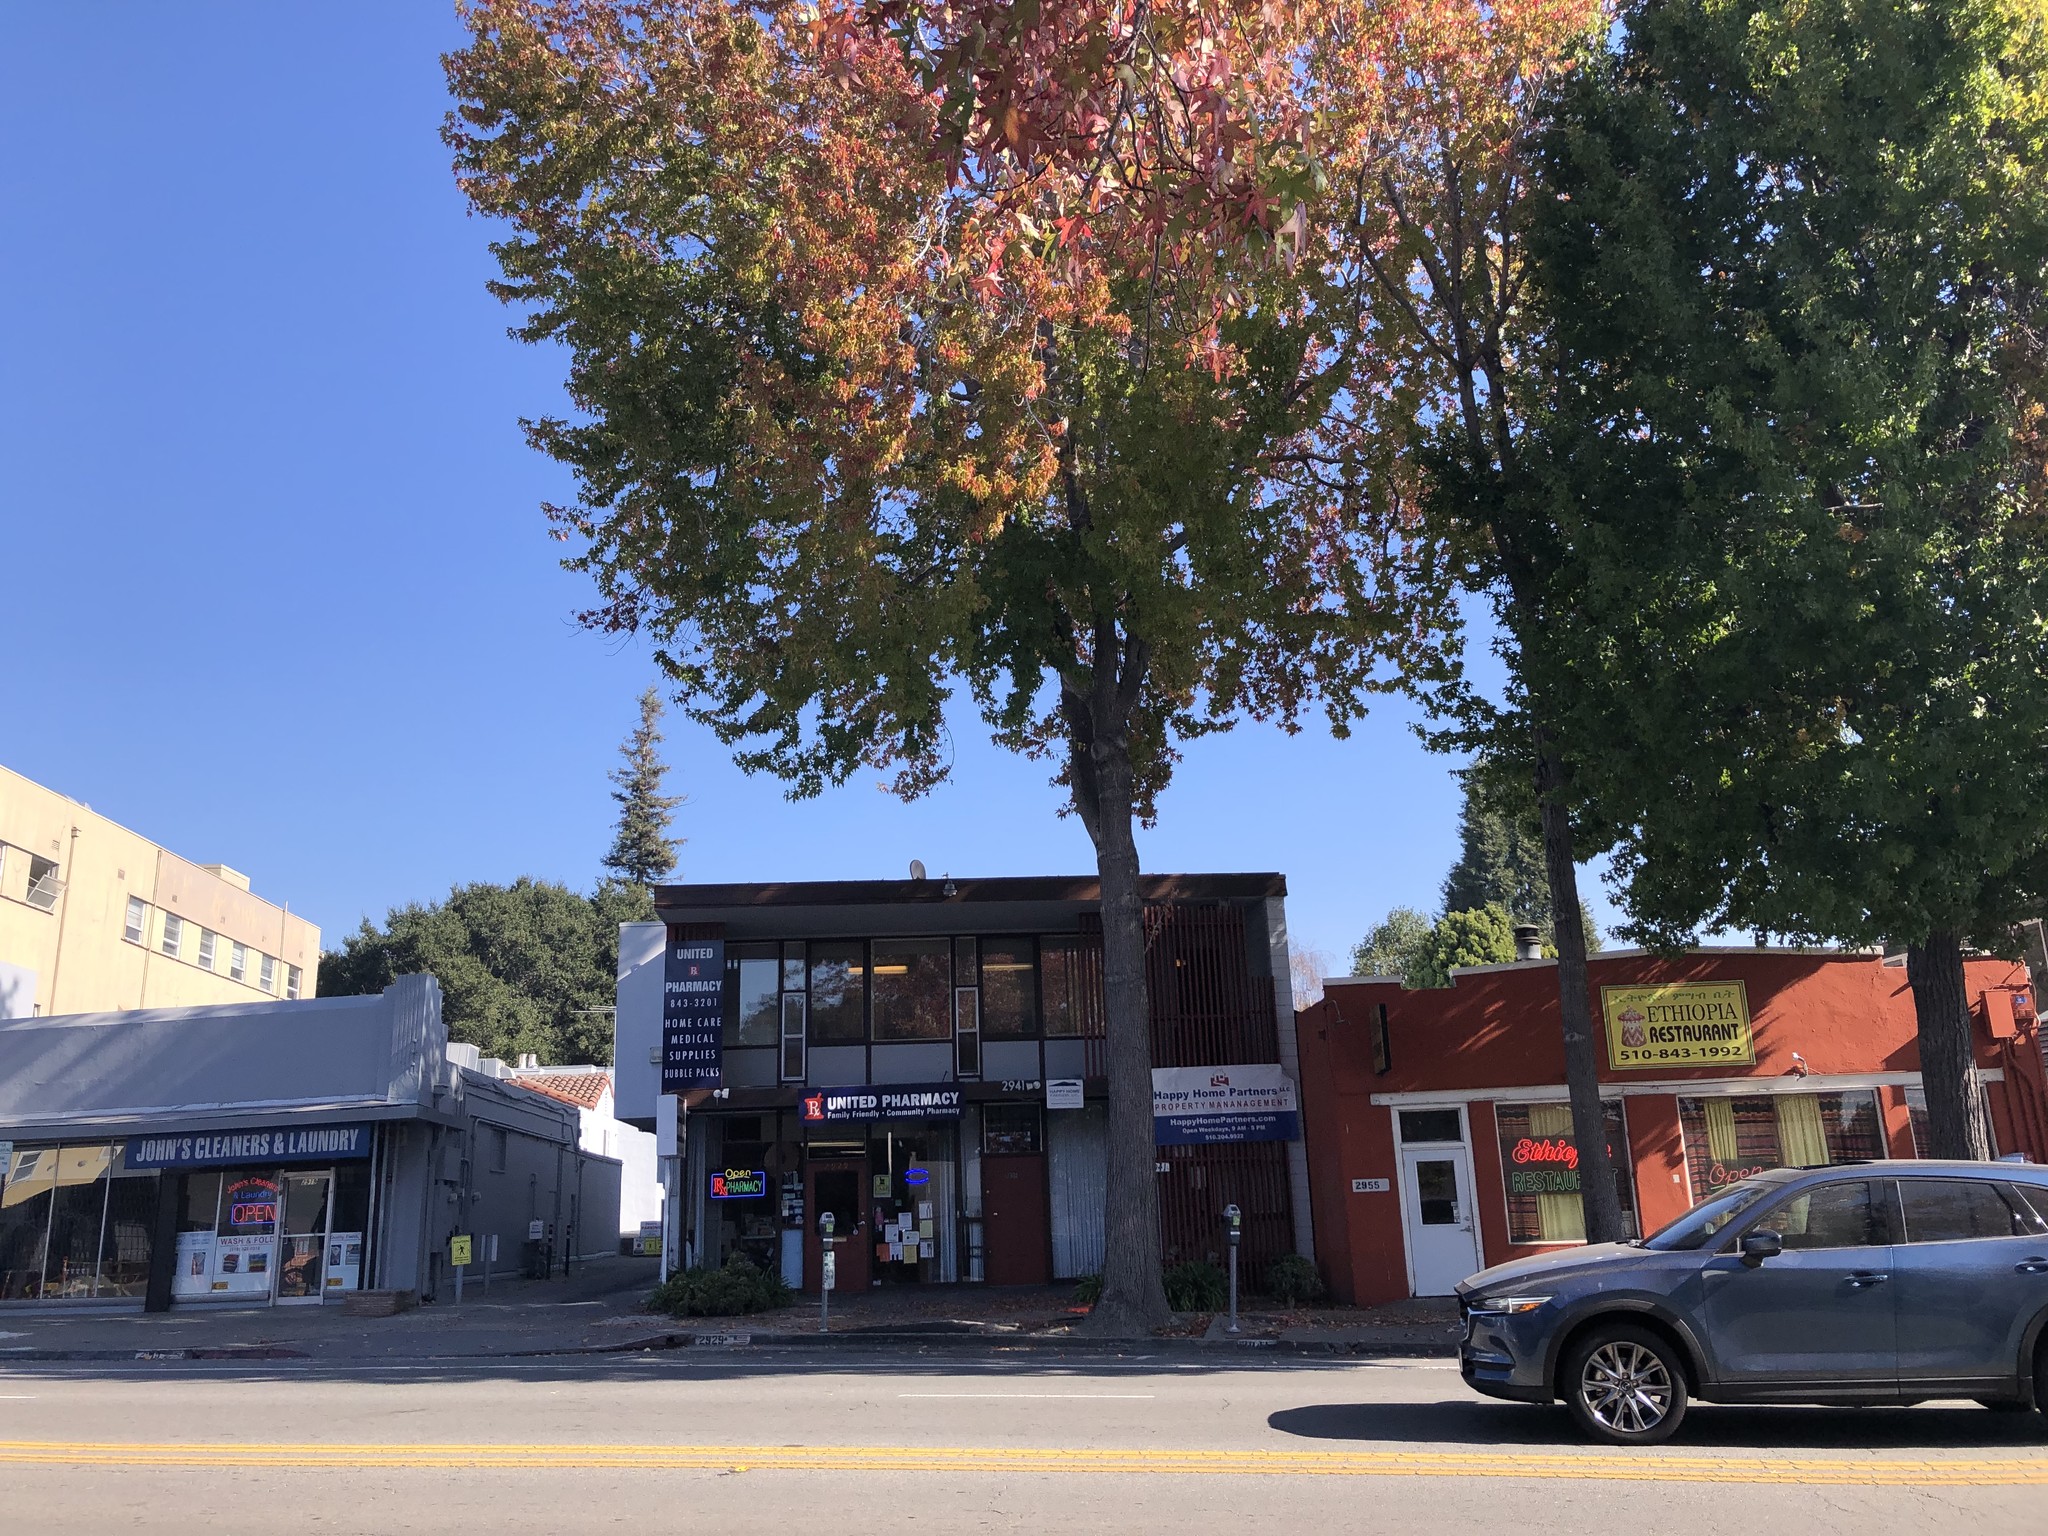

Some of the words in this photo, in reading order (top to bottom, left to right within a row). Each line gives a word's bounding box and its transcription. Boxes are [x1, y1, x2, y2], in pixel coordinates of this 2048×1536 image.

[677, 948, 714, 959] UNITED
[666, 980, 721, 992] PHARMACY
[670, 998, 716, 1008] 843-3201
[1646, 1002, 1738, 1022] ETHIOPIA
[665, 1018, 692, 1028] HOME
[698, 1017, 721, 1026] CARE
[671, 1034, 714, 1044] MEDICAL
[1650, 1024, 1739, 1043] RESTAURANT
[670, 1050, 716, 1060] SUPPLIES
[1620, 1046, 1742, 1060] 510-843-1992
[665, 1068, 692, 1078] BUBBLE
[696, 1067, 719, 1077] PACKS
[1002, 1080, 1024, 1091] 2941
[1154, 1090, 1189, 1102] Happy
[1193, 1089, 1225, 1098] Home
[1229, 1086, 1278, 1097] Partners
[827, 1095, 877, 1110] UNITED
[882, 1092, 959, 1107] PHARMACY
[1155, 1102, 1206, 1111] PROPERTY
[1209, 1099, 1288, 1108] MANANAGEMENT
[827, 1111, 850, 1119] Family
[852, 1110, 880, 1118] Friendly
[886, 1108, 924, 1116] Community
[927, 1107, 960, 1115] Pharmacy
[1170, 1115, 1276, 1126] HappyHomePartners.com
[1199, 1126, 1230, 1134] Weekdays,
[136, 1138, 191, 1162] JOHN'S
[194, 1133, 270, 1160] CLEANERS
[274, 1133, 284, 1155] &
[288, 1128, 359, 1154] LAUNDRY
[725, 1169, 752, 1180] Open
[1710, 1163, 1764, 1187] Open
[726, 1180, 762, 1193] PHARMACY
[1355, 1181, 1380, 1190] 2955
[241, 1190, 272, 1199] Laundry
[234, 1204, 277, 1222] OPEN
[220, 1237, 244, 1245] WASH
[254, 1236, 274, 1244] FOLD
